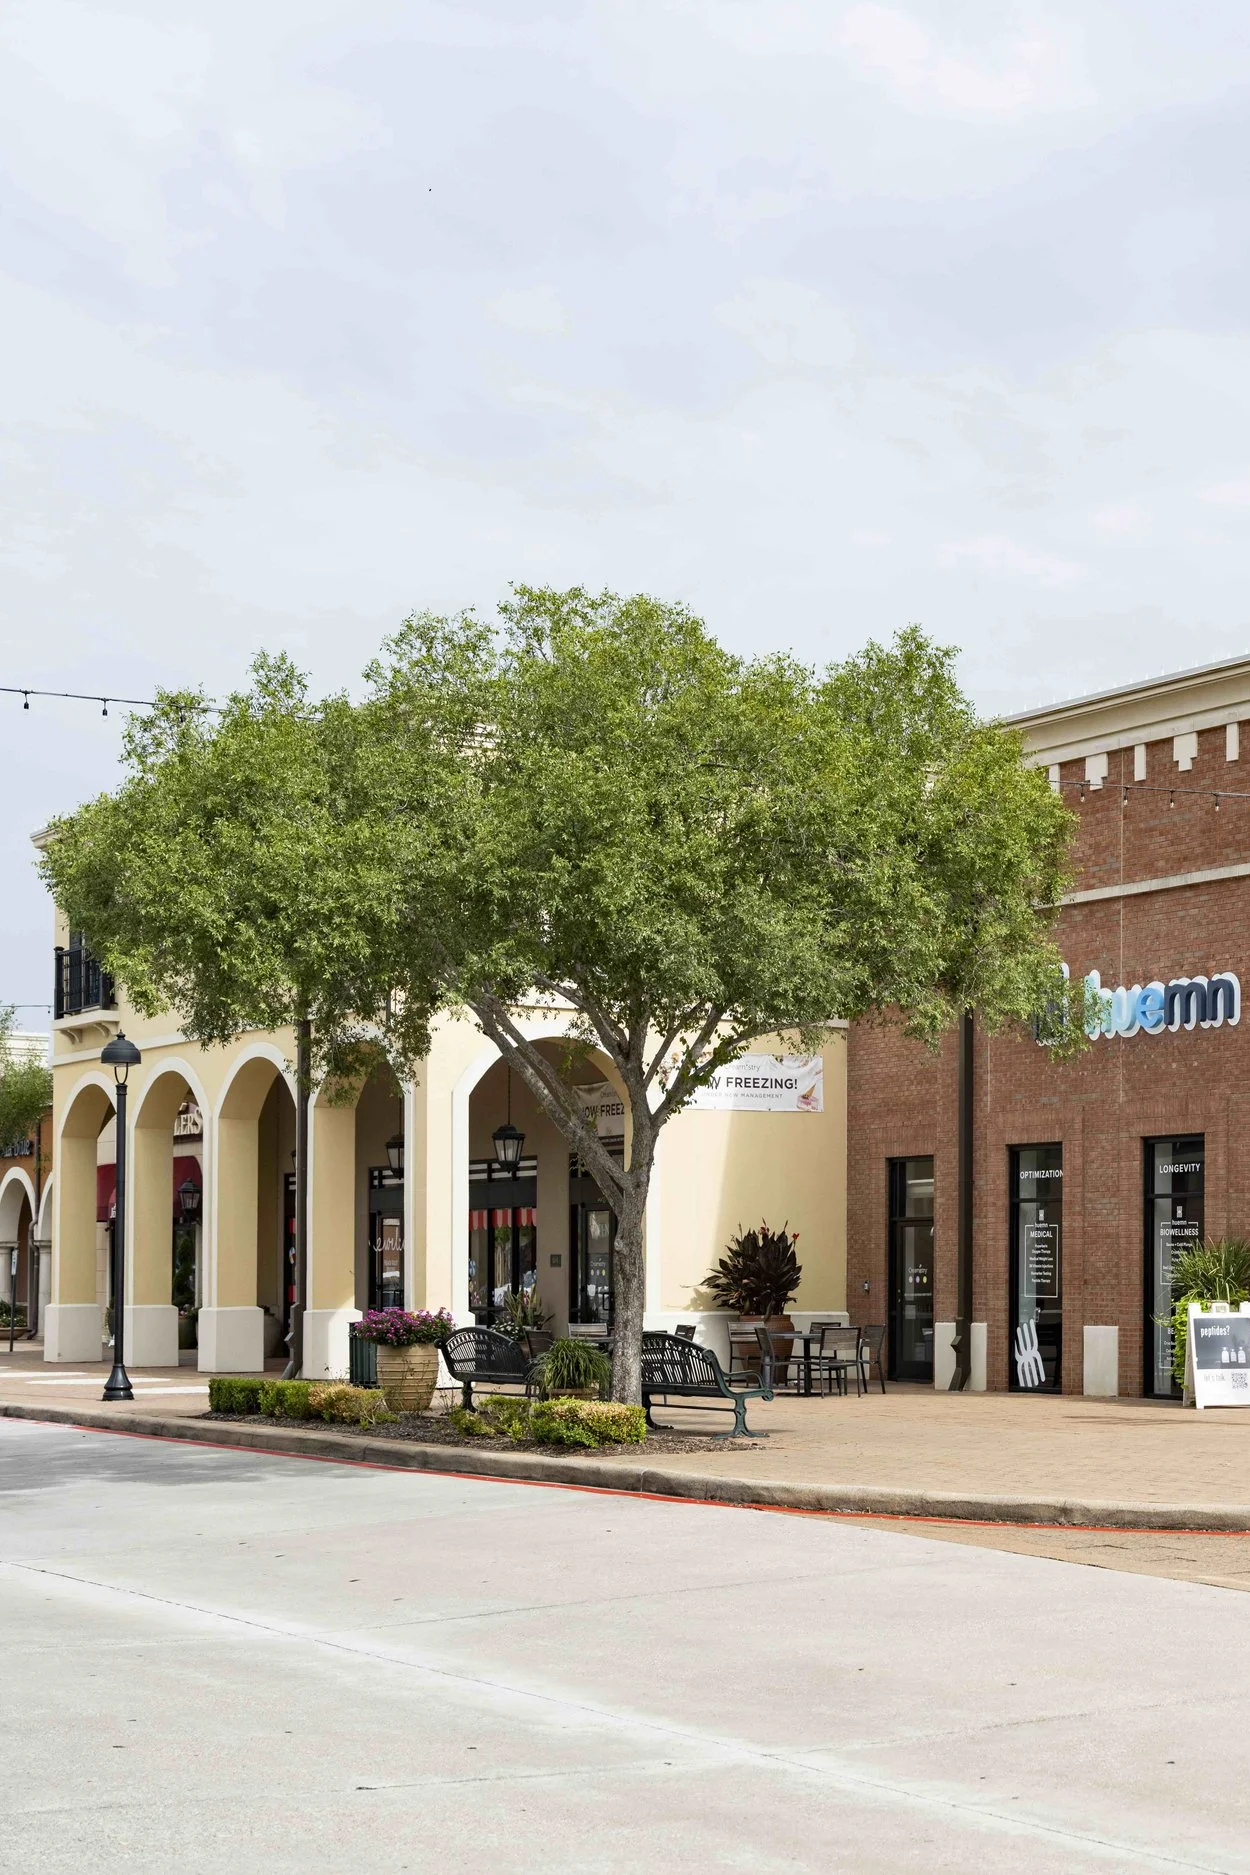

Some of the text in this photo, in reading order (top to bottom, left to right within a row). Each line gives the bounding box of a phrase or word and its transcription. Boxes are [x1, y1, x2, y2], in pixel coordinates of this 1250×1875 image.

[1083, 972, 1238, 1038] huemn
[726, 1076, 798, 1090] FREEZING!
[582, 1106, 598, 1118] OW
[1020, 1169, 1064, 1179] OPTIMIZATION
[1160, 1163, 1201, 1174] LONGEVITY
[1030, 1230, 1053, 1238] MEDICAL
[1160, 1228, 1199, 1236] BIOWELLNESS
[1200, 1325, 1230, 1338] peptides?
